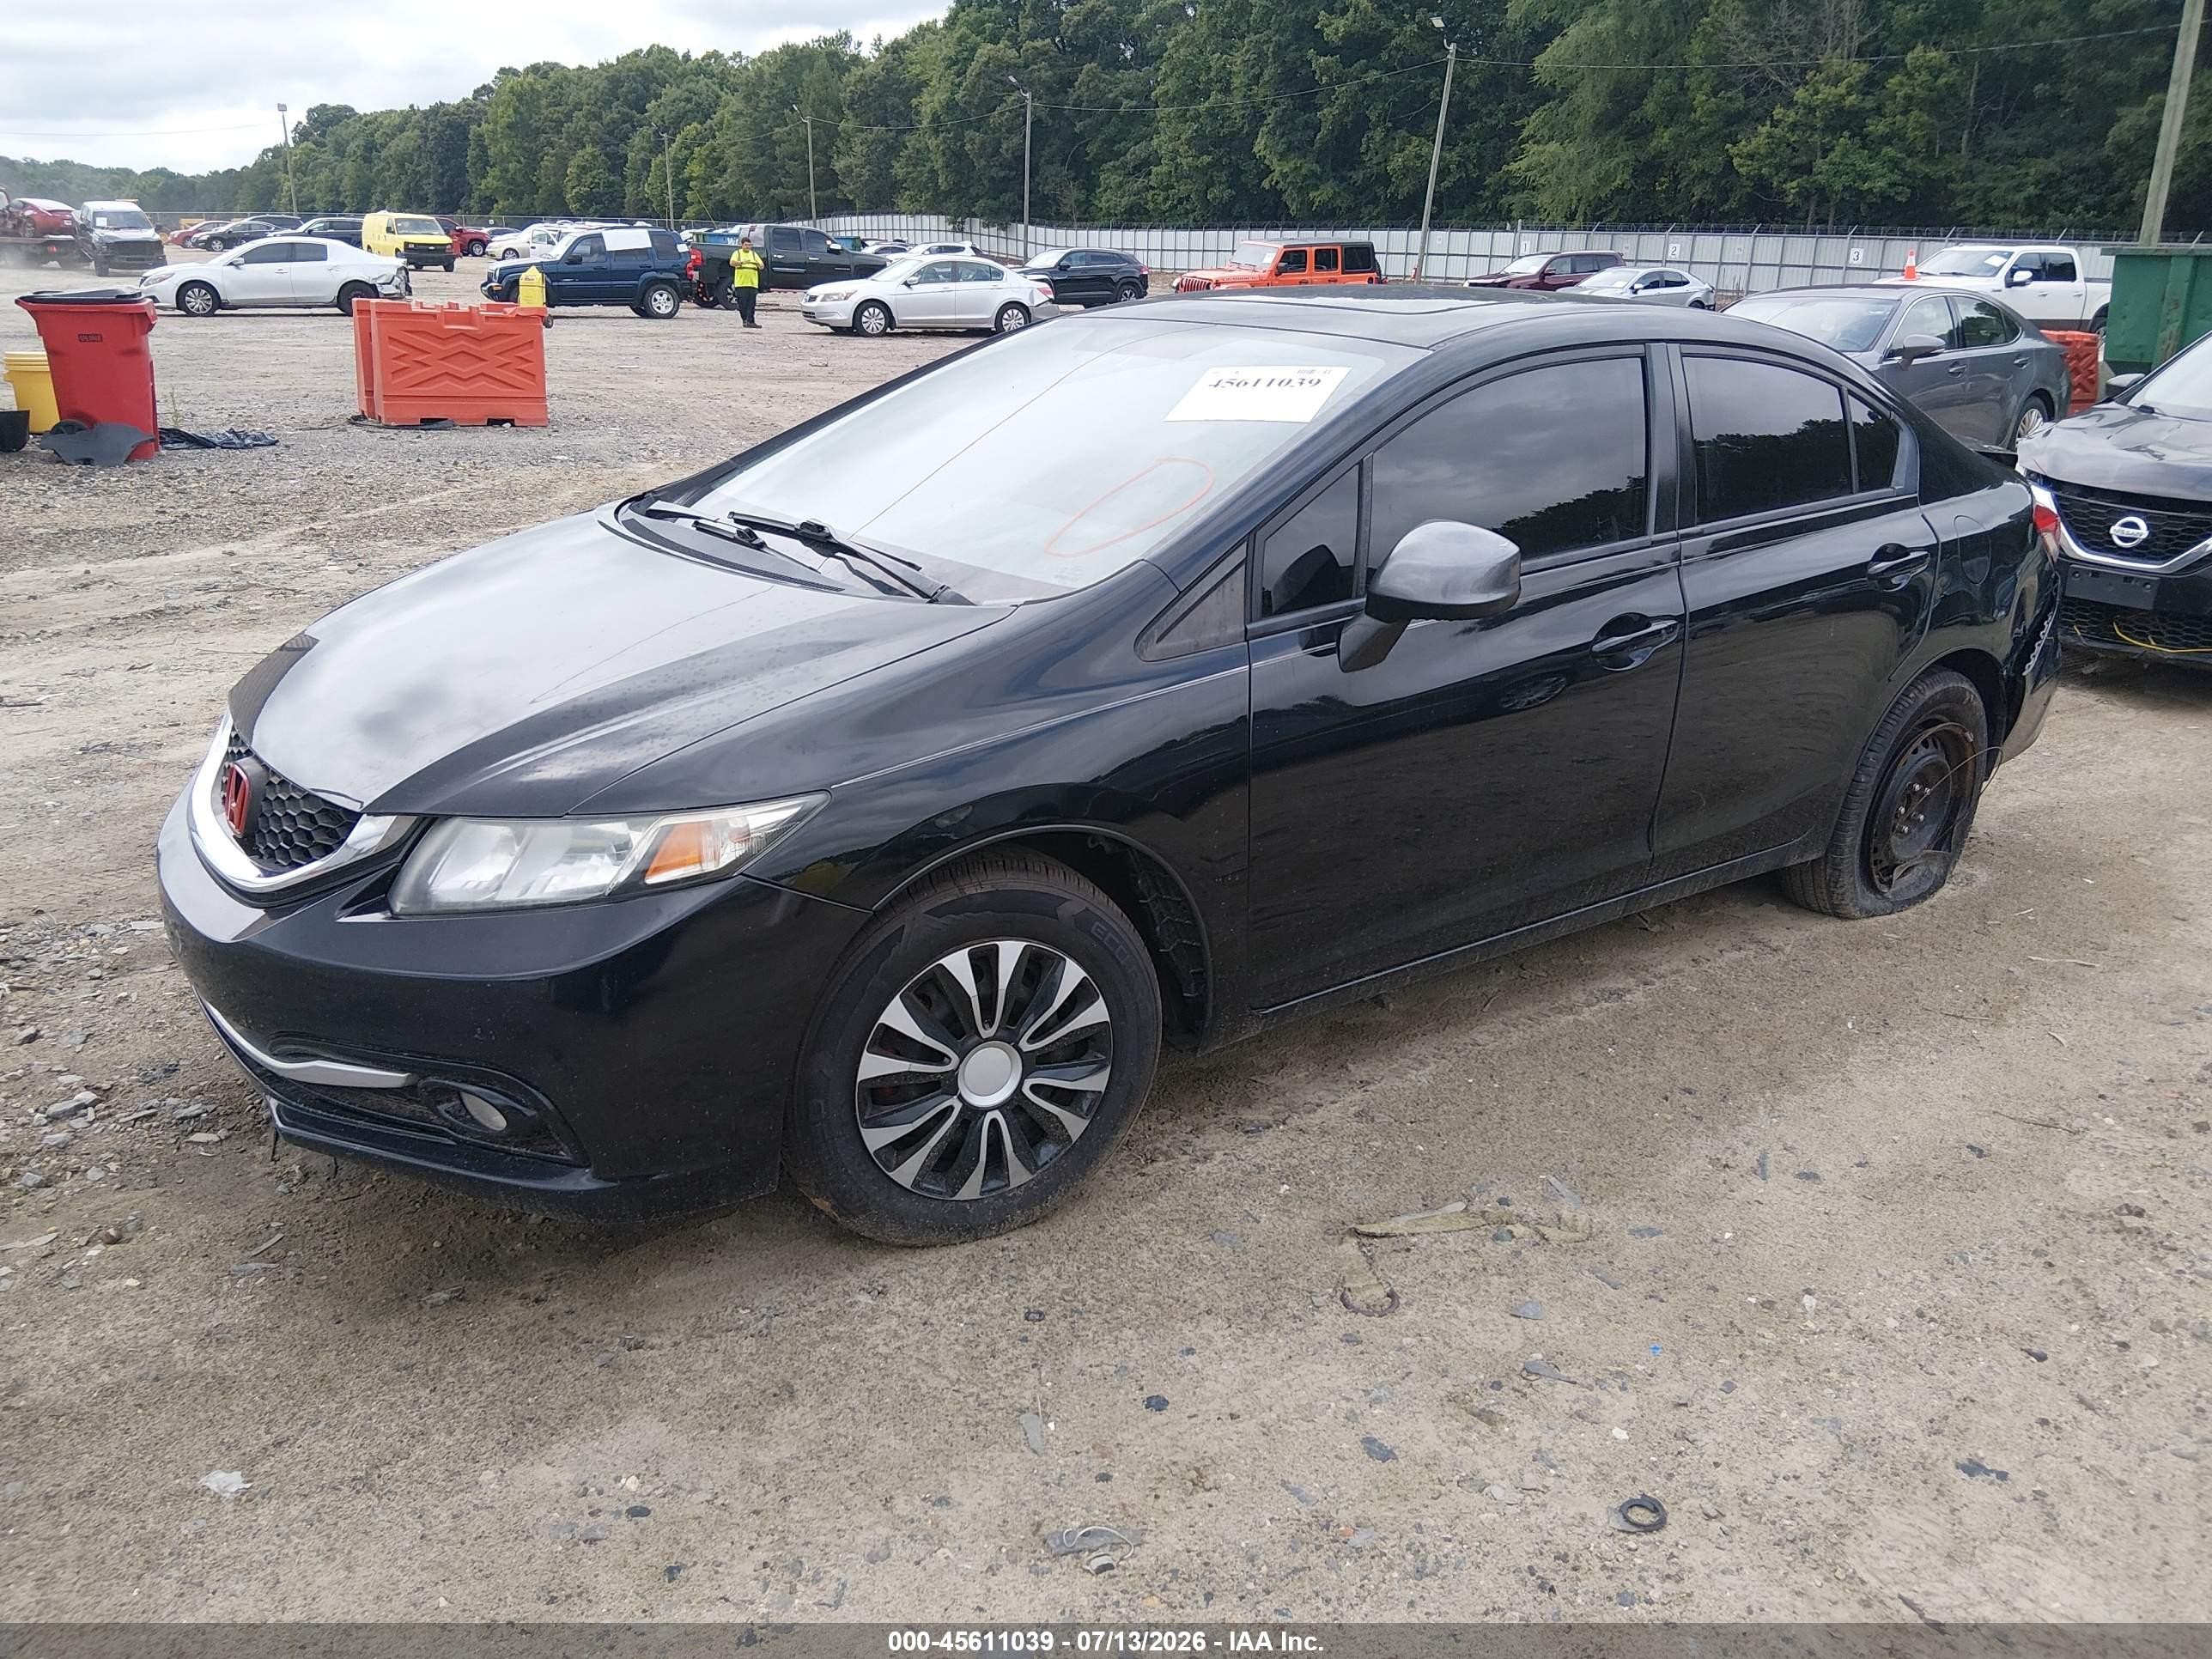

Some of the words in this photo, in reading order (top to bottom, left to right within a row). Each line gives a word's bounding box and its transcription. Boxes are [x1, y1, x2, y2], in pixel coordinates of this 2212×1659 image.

[1671, 246, 1677, 257] 2
[1853, 251, 1860, 261] 3
[1208, 377, 1322, 389] 45611039
